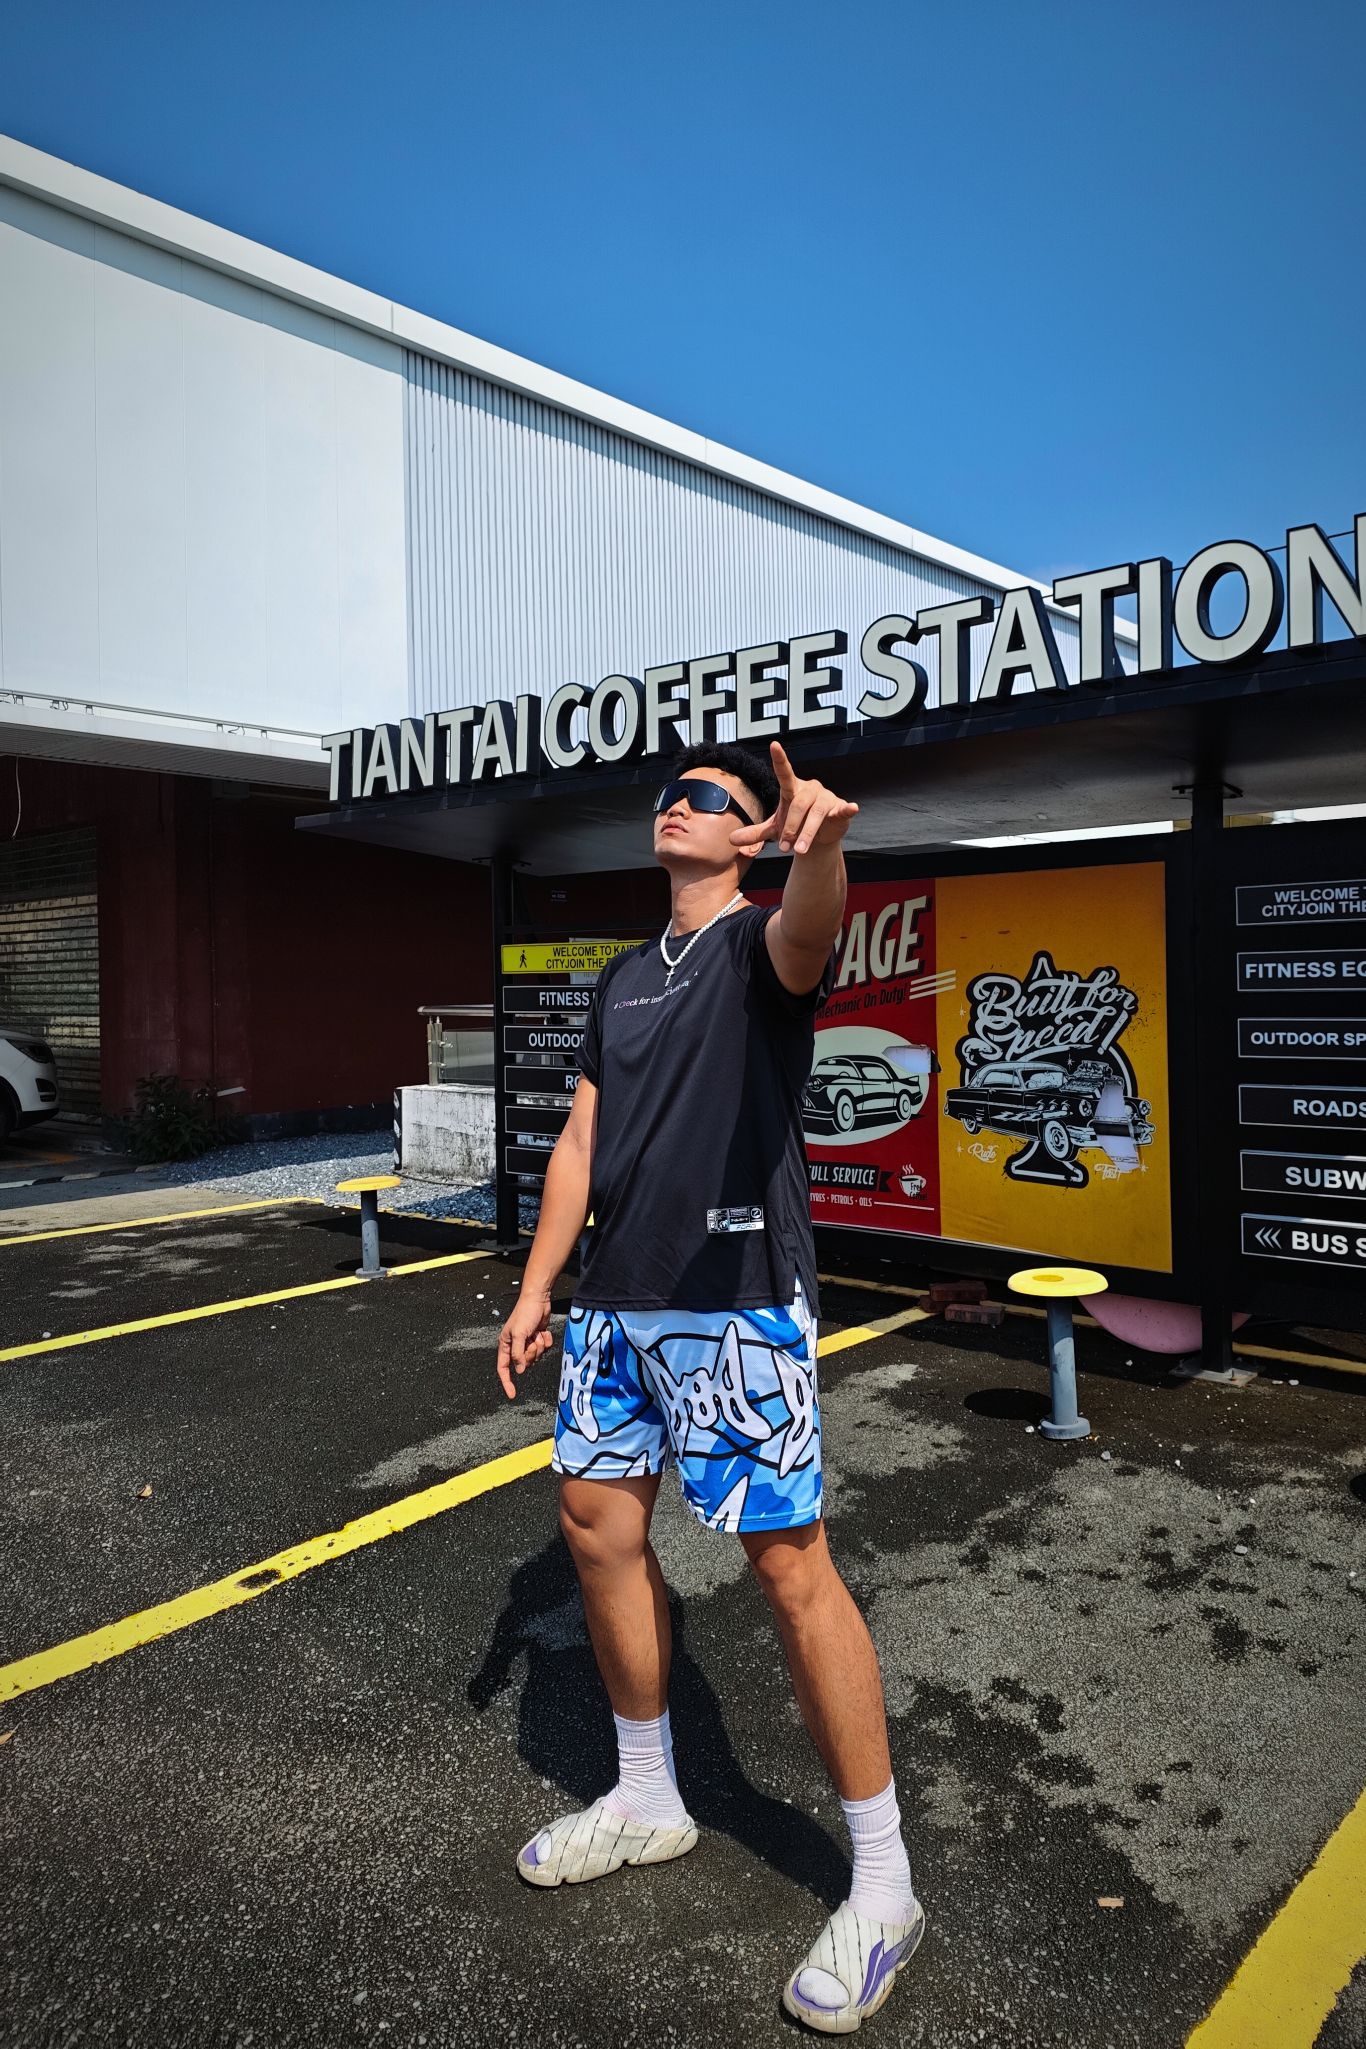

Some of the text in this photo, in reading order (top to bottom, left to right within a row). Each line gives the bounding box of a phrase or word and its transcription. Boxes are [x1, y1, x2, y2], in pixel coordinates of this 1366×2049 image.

[322, 512, 1366, 800] TIANTAI COFFEE STATION
[1274, 887, 1359, 903] WELCOME
[834, 895, 927, 988] AGE
[552, 945, 598, 957] WELCOME
[600, 945, 612, 956] TO
[586, 957, 604, 968] THE
[1245, 961, 1336, 979] FITNESS
[539, 991, 590, 1007] FITNESS
[972, 974, 1084, 1020] Built
[1251, 1032, 1339, 1046] OUTDOOR
[808, 1165, 876, 1186] ULL SERVICE
[1291, 1230, 1348, 1255] BUS
